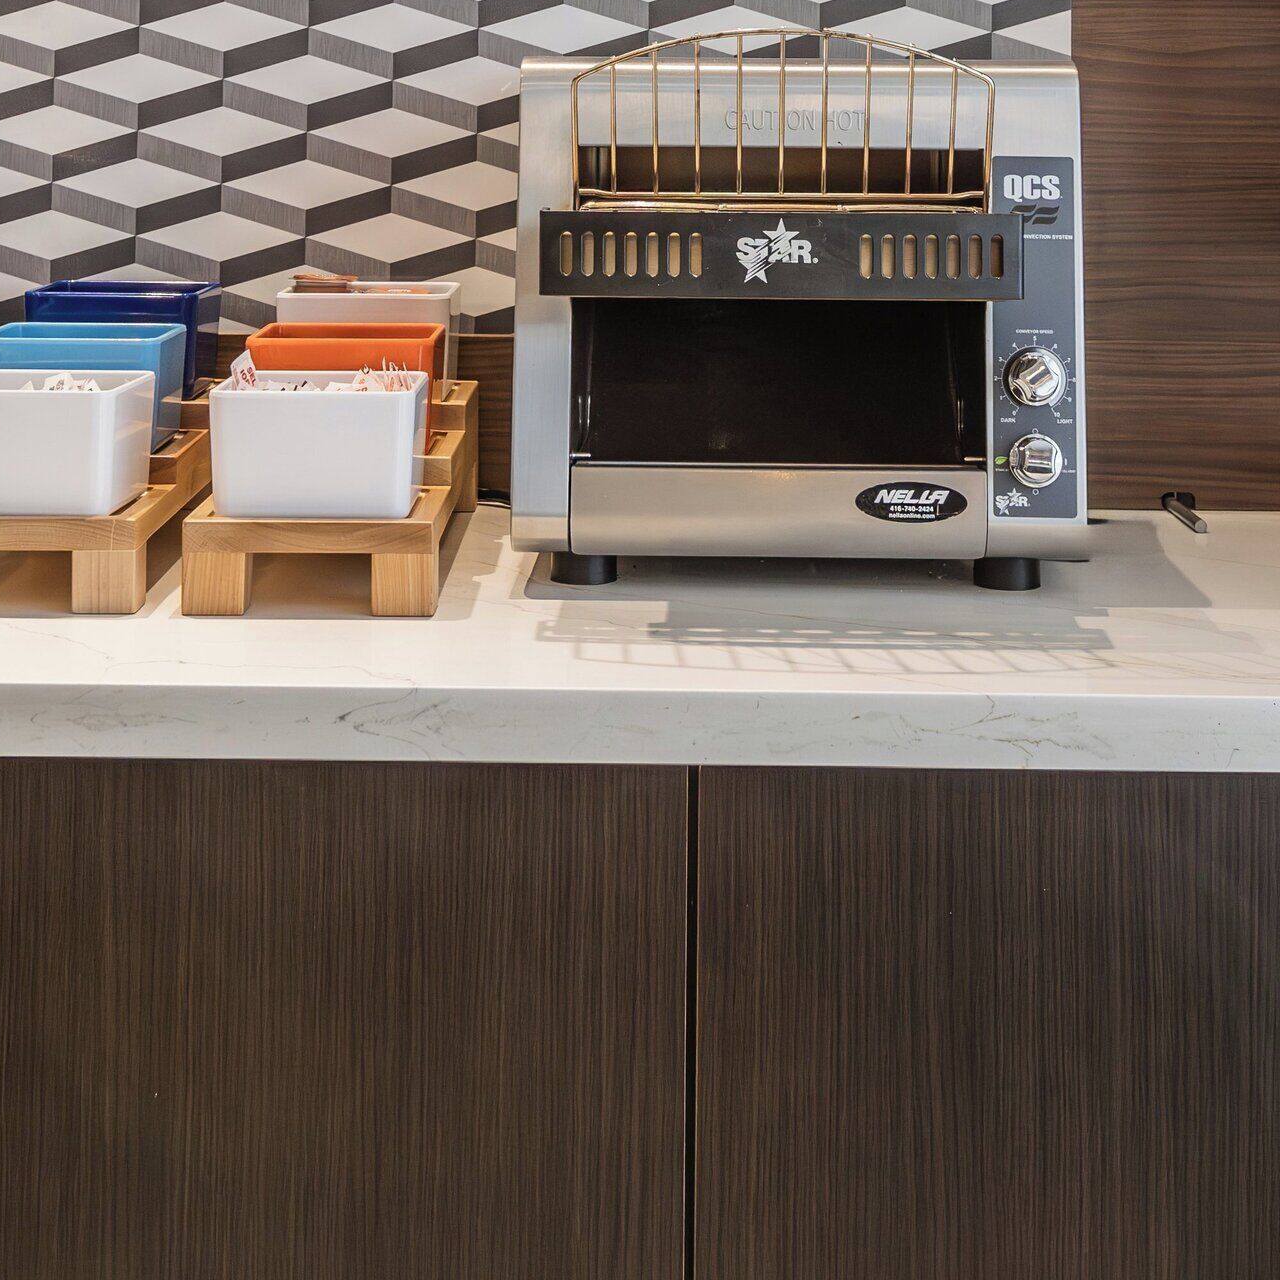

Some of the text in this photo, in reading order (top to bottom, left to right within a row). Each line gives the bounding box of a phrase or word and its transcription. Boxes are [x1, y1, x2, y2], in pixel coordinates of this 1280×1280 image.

[724, 108, 816, 131] CAUTON
[1003, 174, 1061, 203] QCS
[873, 489, 950, 505] NELLA
